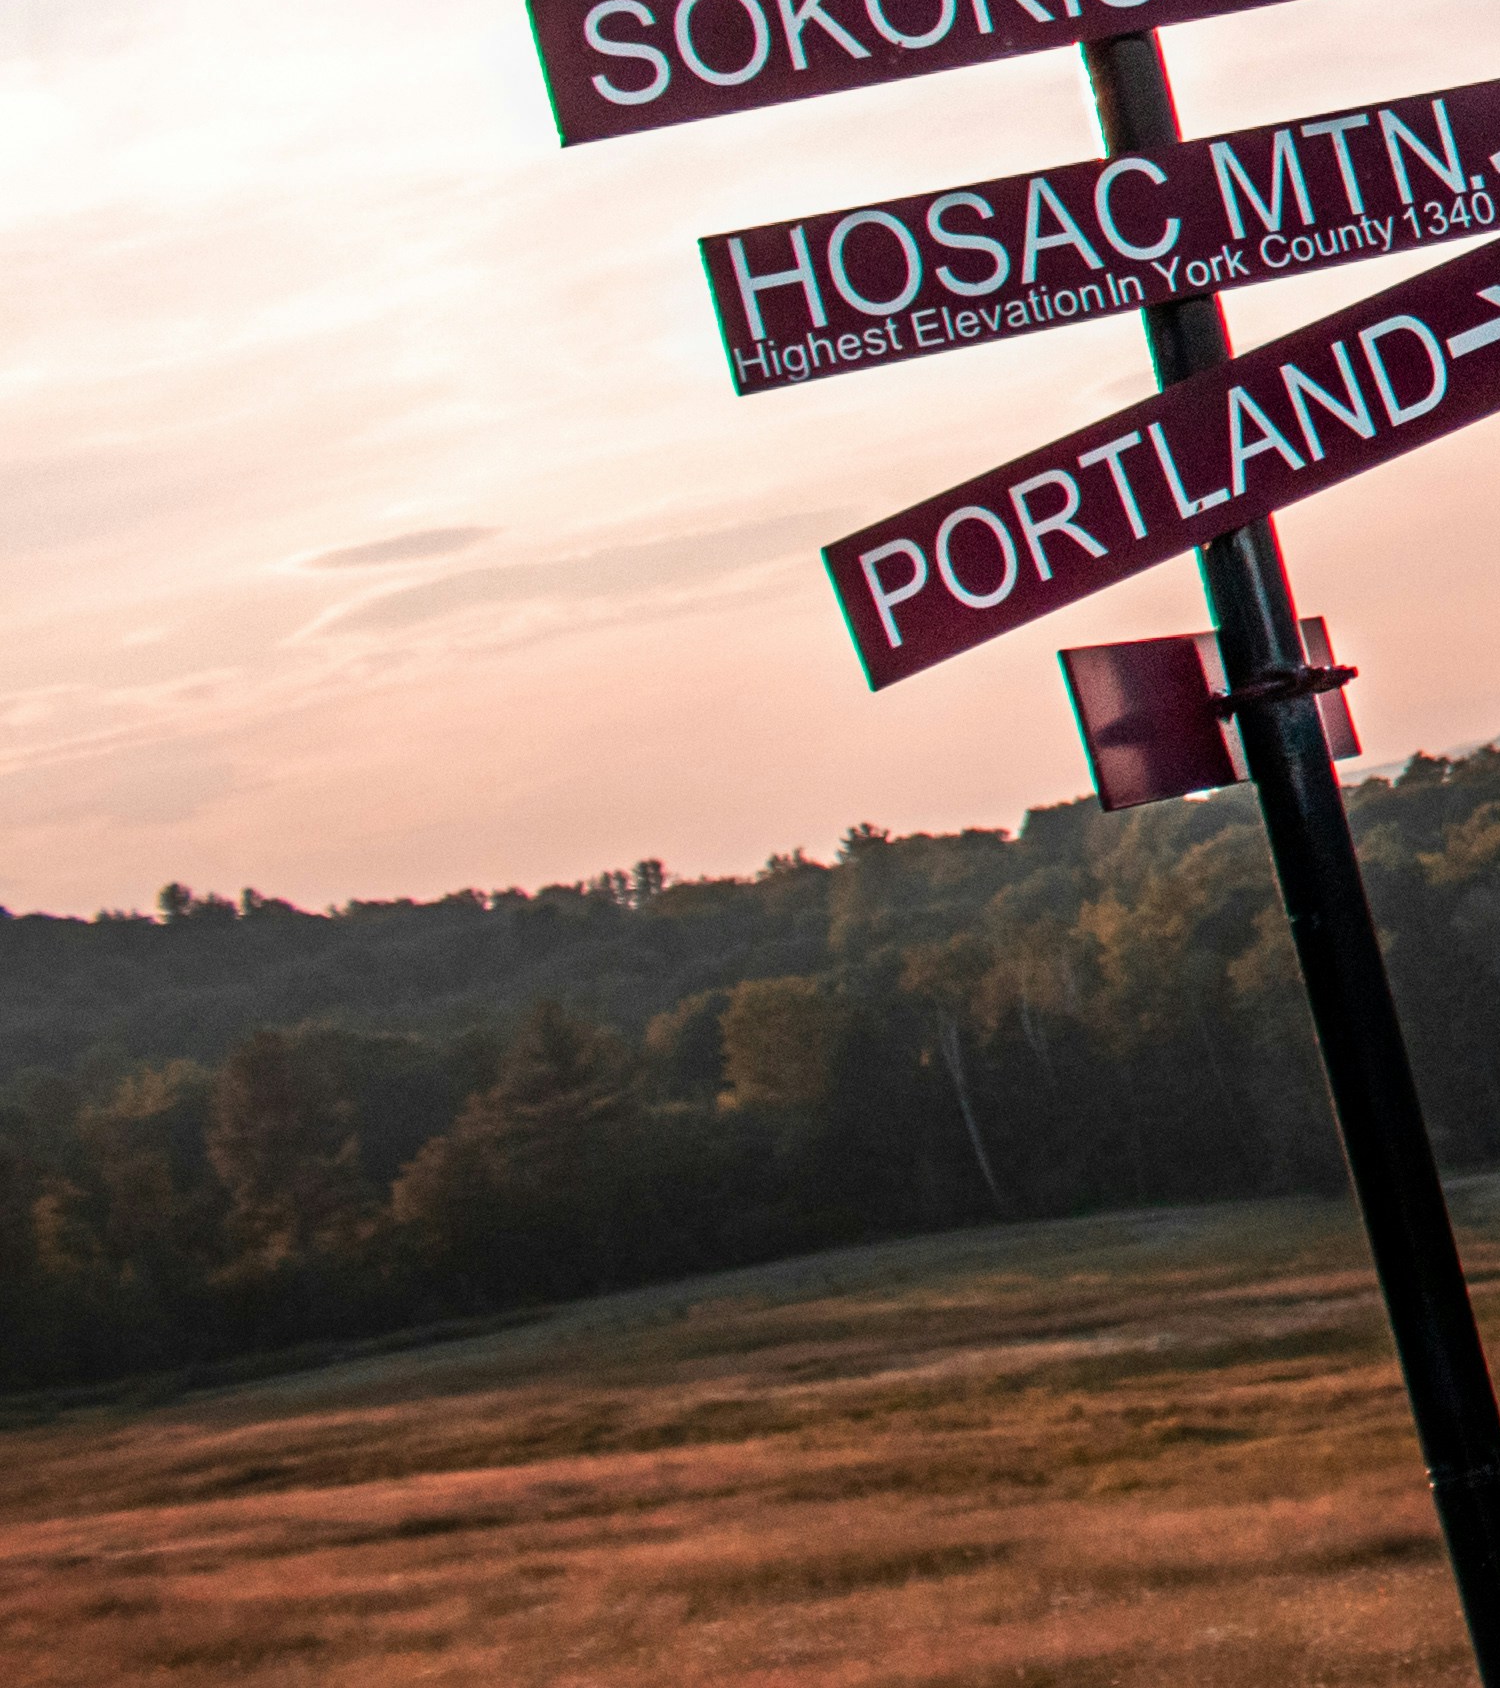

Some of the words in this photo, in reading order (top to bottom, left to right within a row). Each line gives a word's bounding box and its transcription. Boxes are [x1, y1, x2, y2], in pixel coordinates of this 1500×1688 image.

[728, 157, 1182, 342] HOSAC
[1209, 99, 1486, 239] MTN.
[733, 318, 903, 384] Highest
[911, 284, 1105, 348] Elevation
[1152, 246, 1249, 292] York
[1260, 216, 1395, 269] County
[1403, 190, 1496, 239] 1340
[861, 313, 1449, 649] PORTLAND
